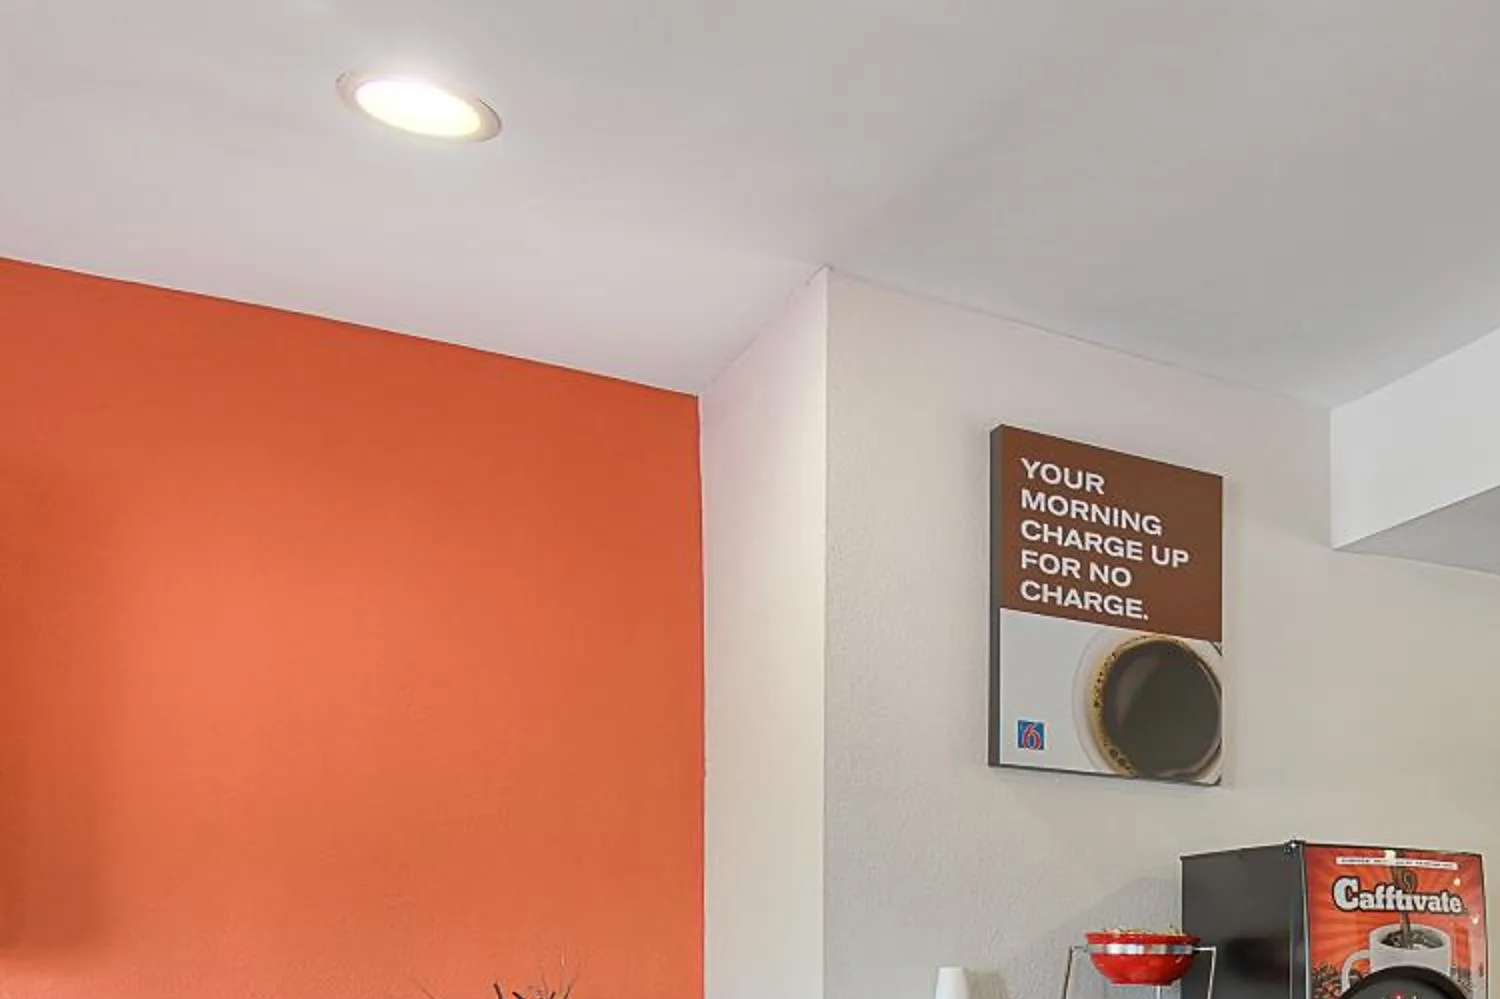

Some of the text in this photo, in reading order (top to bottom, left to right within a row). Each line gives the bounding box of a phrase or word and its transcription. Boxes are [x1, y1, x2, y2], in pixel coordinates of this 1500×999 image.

[1020, 457, 1105, 495] YOUR
[1021, 488, 1162, 536] MORNING
[1020, 519, 1189, 568] CHARGE UP
[1021, 549, 1132, 588] FOR NO
[1020, 579, 1149, 621] CHARGE.
[1333, 876, 1463, 914] Cafftivate
